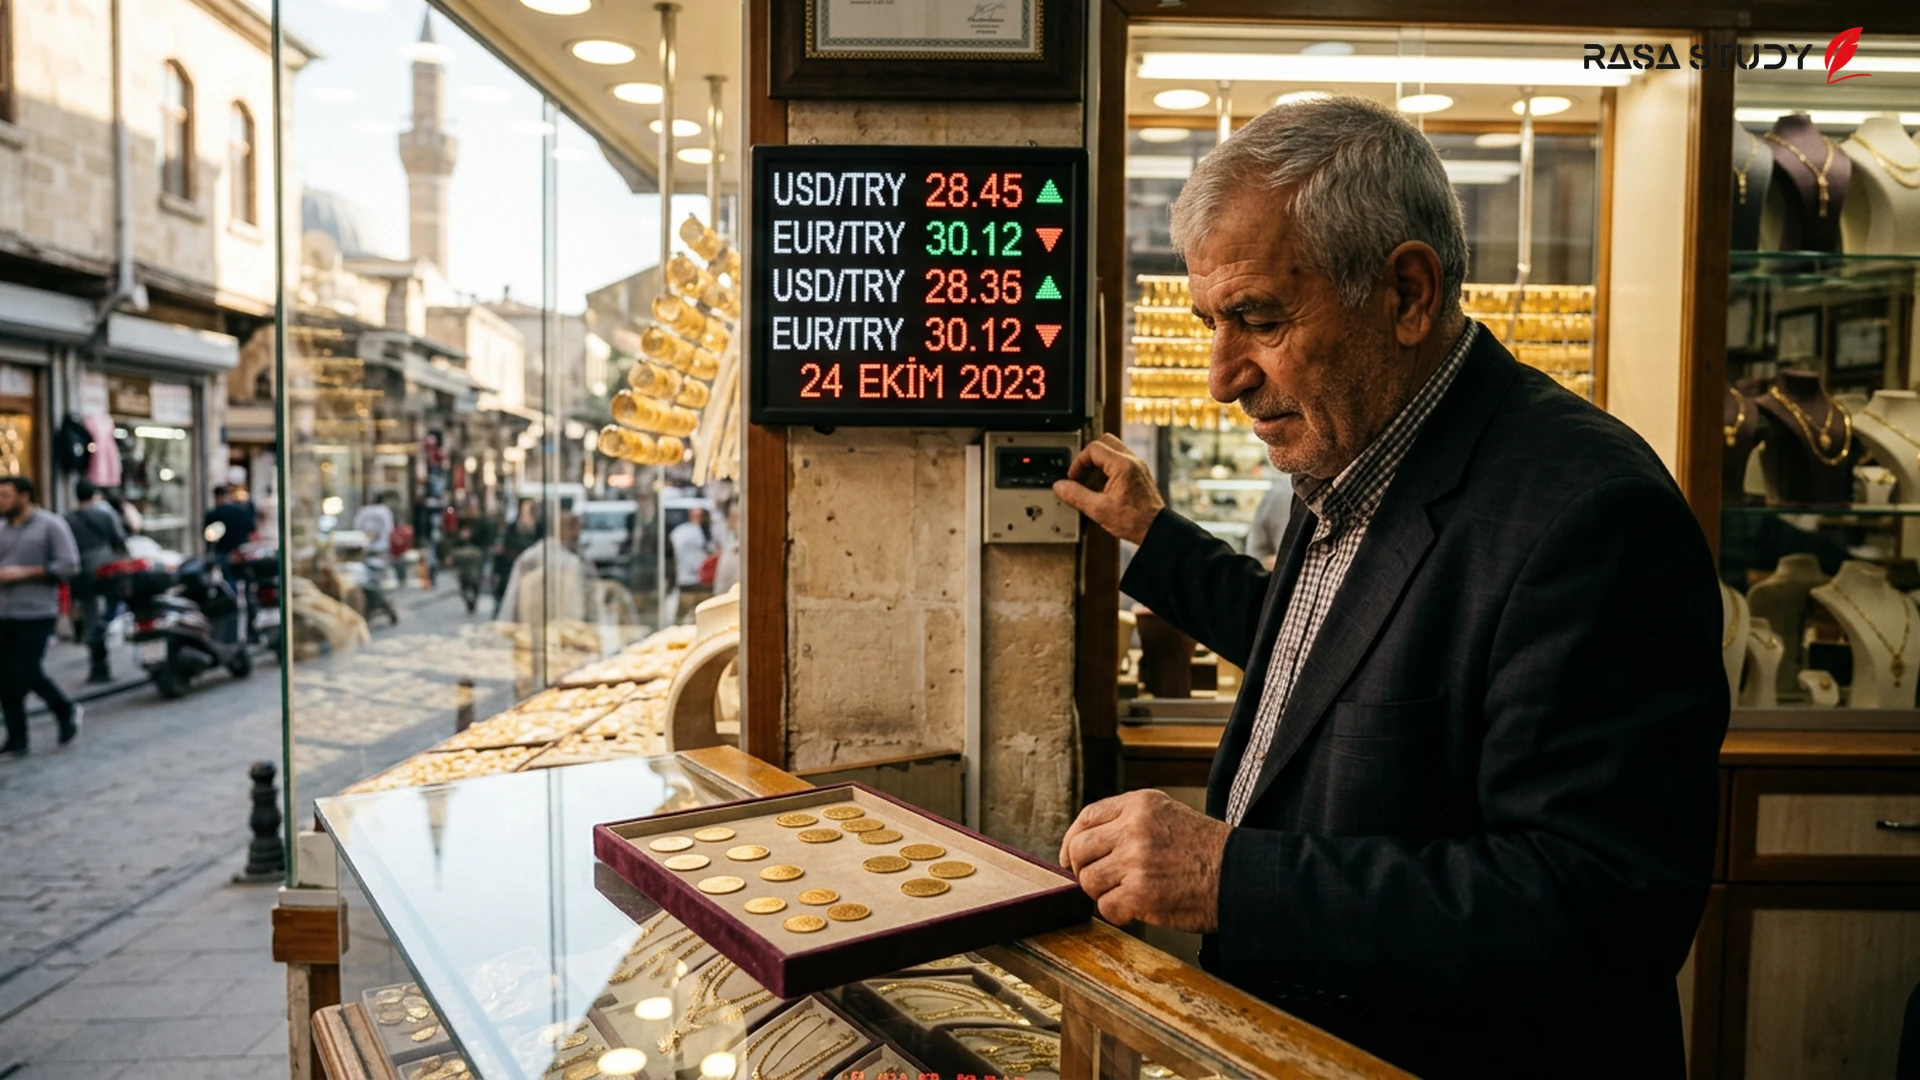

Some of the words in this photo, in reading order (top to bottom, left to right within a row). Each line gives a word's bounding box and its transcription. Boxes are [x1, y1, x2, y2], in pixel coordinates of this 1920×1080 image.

[773, 172, 906, 206] USD/TRY
[926, 173, 1023, 207] 28.45
[773, 220, 905, 254] EUR/TRY
[926, 221, 1022, 256] 30.12
[773, 268, 905, 302] USD/TRY
[773, 316, 904, 350] EUR/TRY
[925, 317, 1021, 352] 30.12
[801, 363, 843, 398] 24
[859, 357, 943, 398] EKİM
[960, 365, 1046, 399] 2023
